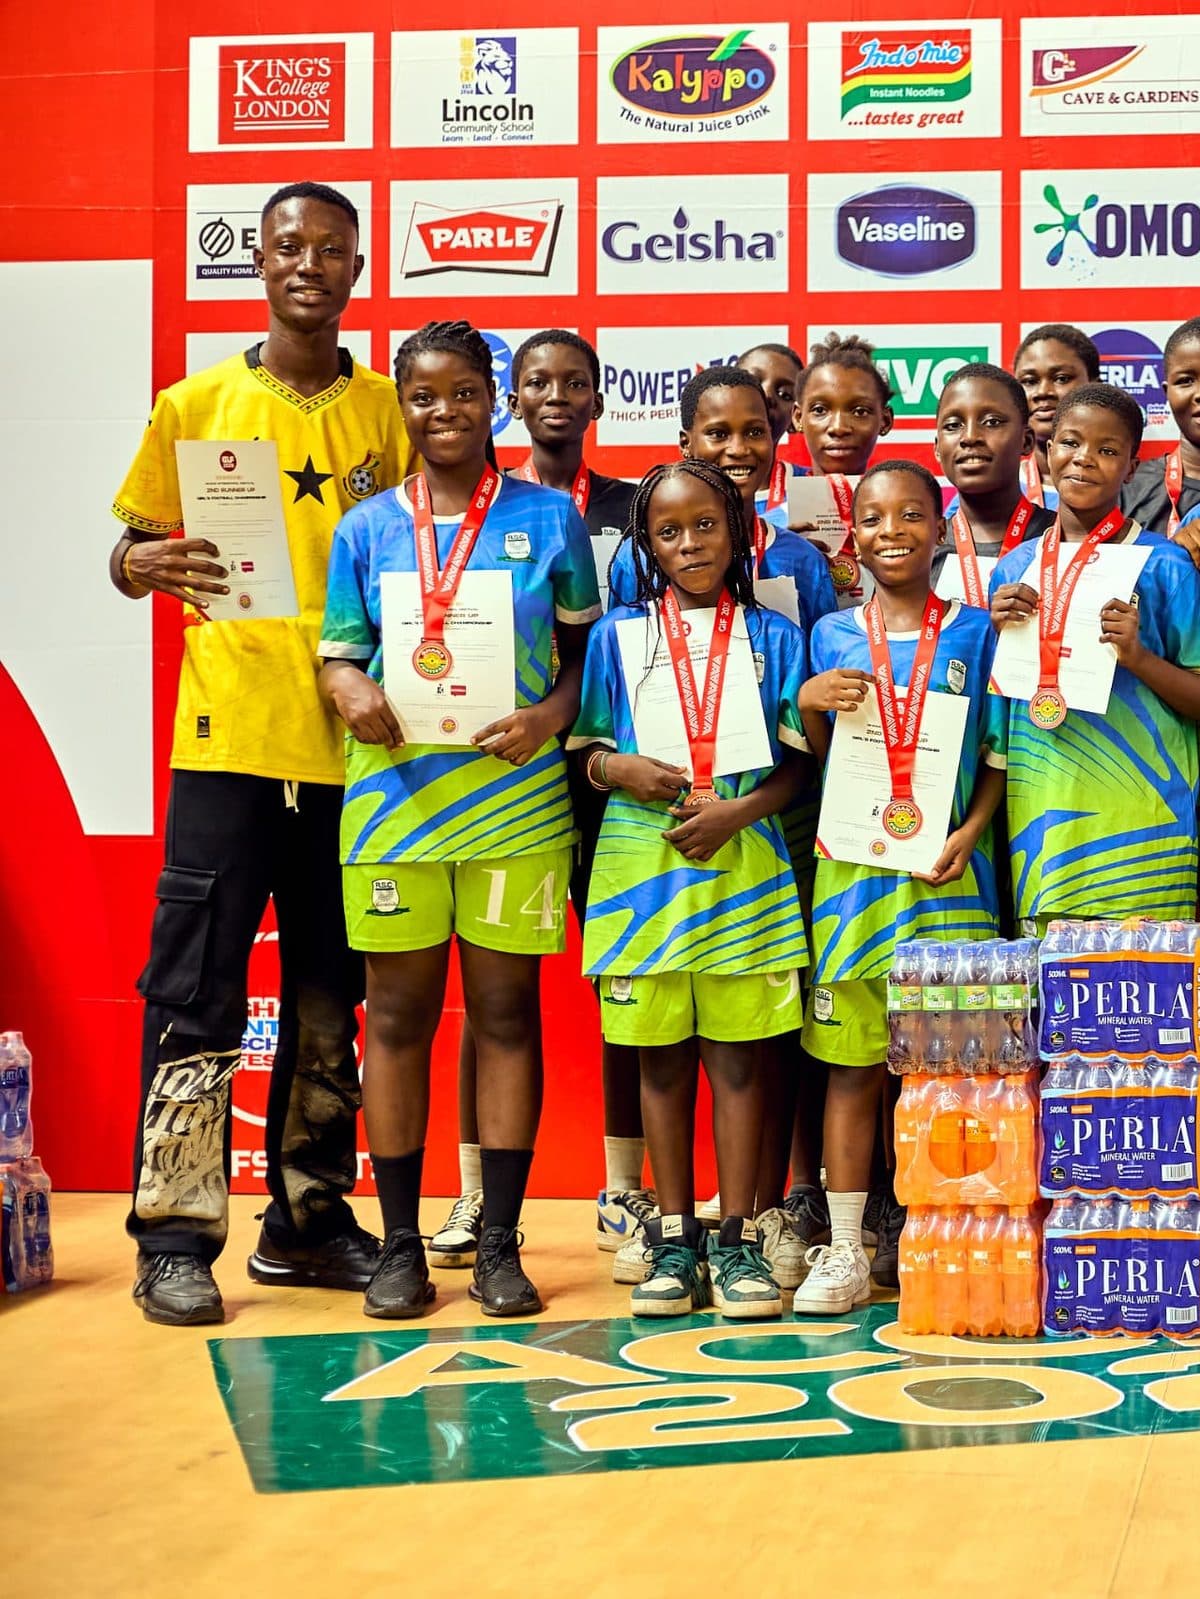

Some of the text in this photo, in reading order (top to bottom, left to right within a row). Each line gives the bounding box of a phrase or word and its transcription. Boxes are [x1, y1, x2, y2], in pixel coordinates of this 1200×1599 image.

[234, 57, 331, 96] KING'S
[266, 76, 329, 97] College
[629, 54, 766, 103] Kalyppo
[869, 86, 945, 98] Instant Noodles
[1062, 90, 1199, 105] CAVE & GARDENS
[234, 99, 331, 119] LONDON
[442, 98, 534, 121] Lincoln
[619, 104, 771, 133] The Natural Juice Drink
[917, 109, 964, 129] great
[442, 121, 534, 134] Community School
[430, 225, 534, 248] PARLE
[602, 209, 776, 264] Geisha
[847, 215, 966, 242] Vaseline
[1095, 204, 1200, 258] OMO
[201, 267, 230, 275] QUALITY
[231, 266, 253, 274] HOME
[609, 410, 646, 421] THICK
[474, 868, 563, 931] 14
[1071, 981, 1192, 1020] PERLA
[1098, 1016, 1153, 1025] MINERAL WATER
[1072, 1116, 1195, 1155] PERLA
[1101, 1152, 1156, 1163] MINERAL WATER
[1053, 1246, 1072, 1254] 500ML
[1076, 1258, 1200, 1298] PERLA
[1104, 1294, 1160, 1305] MINERAL WATER
